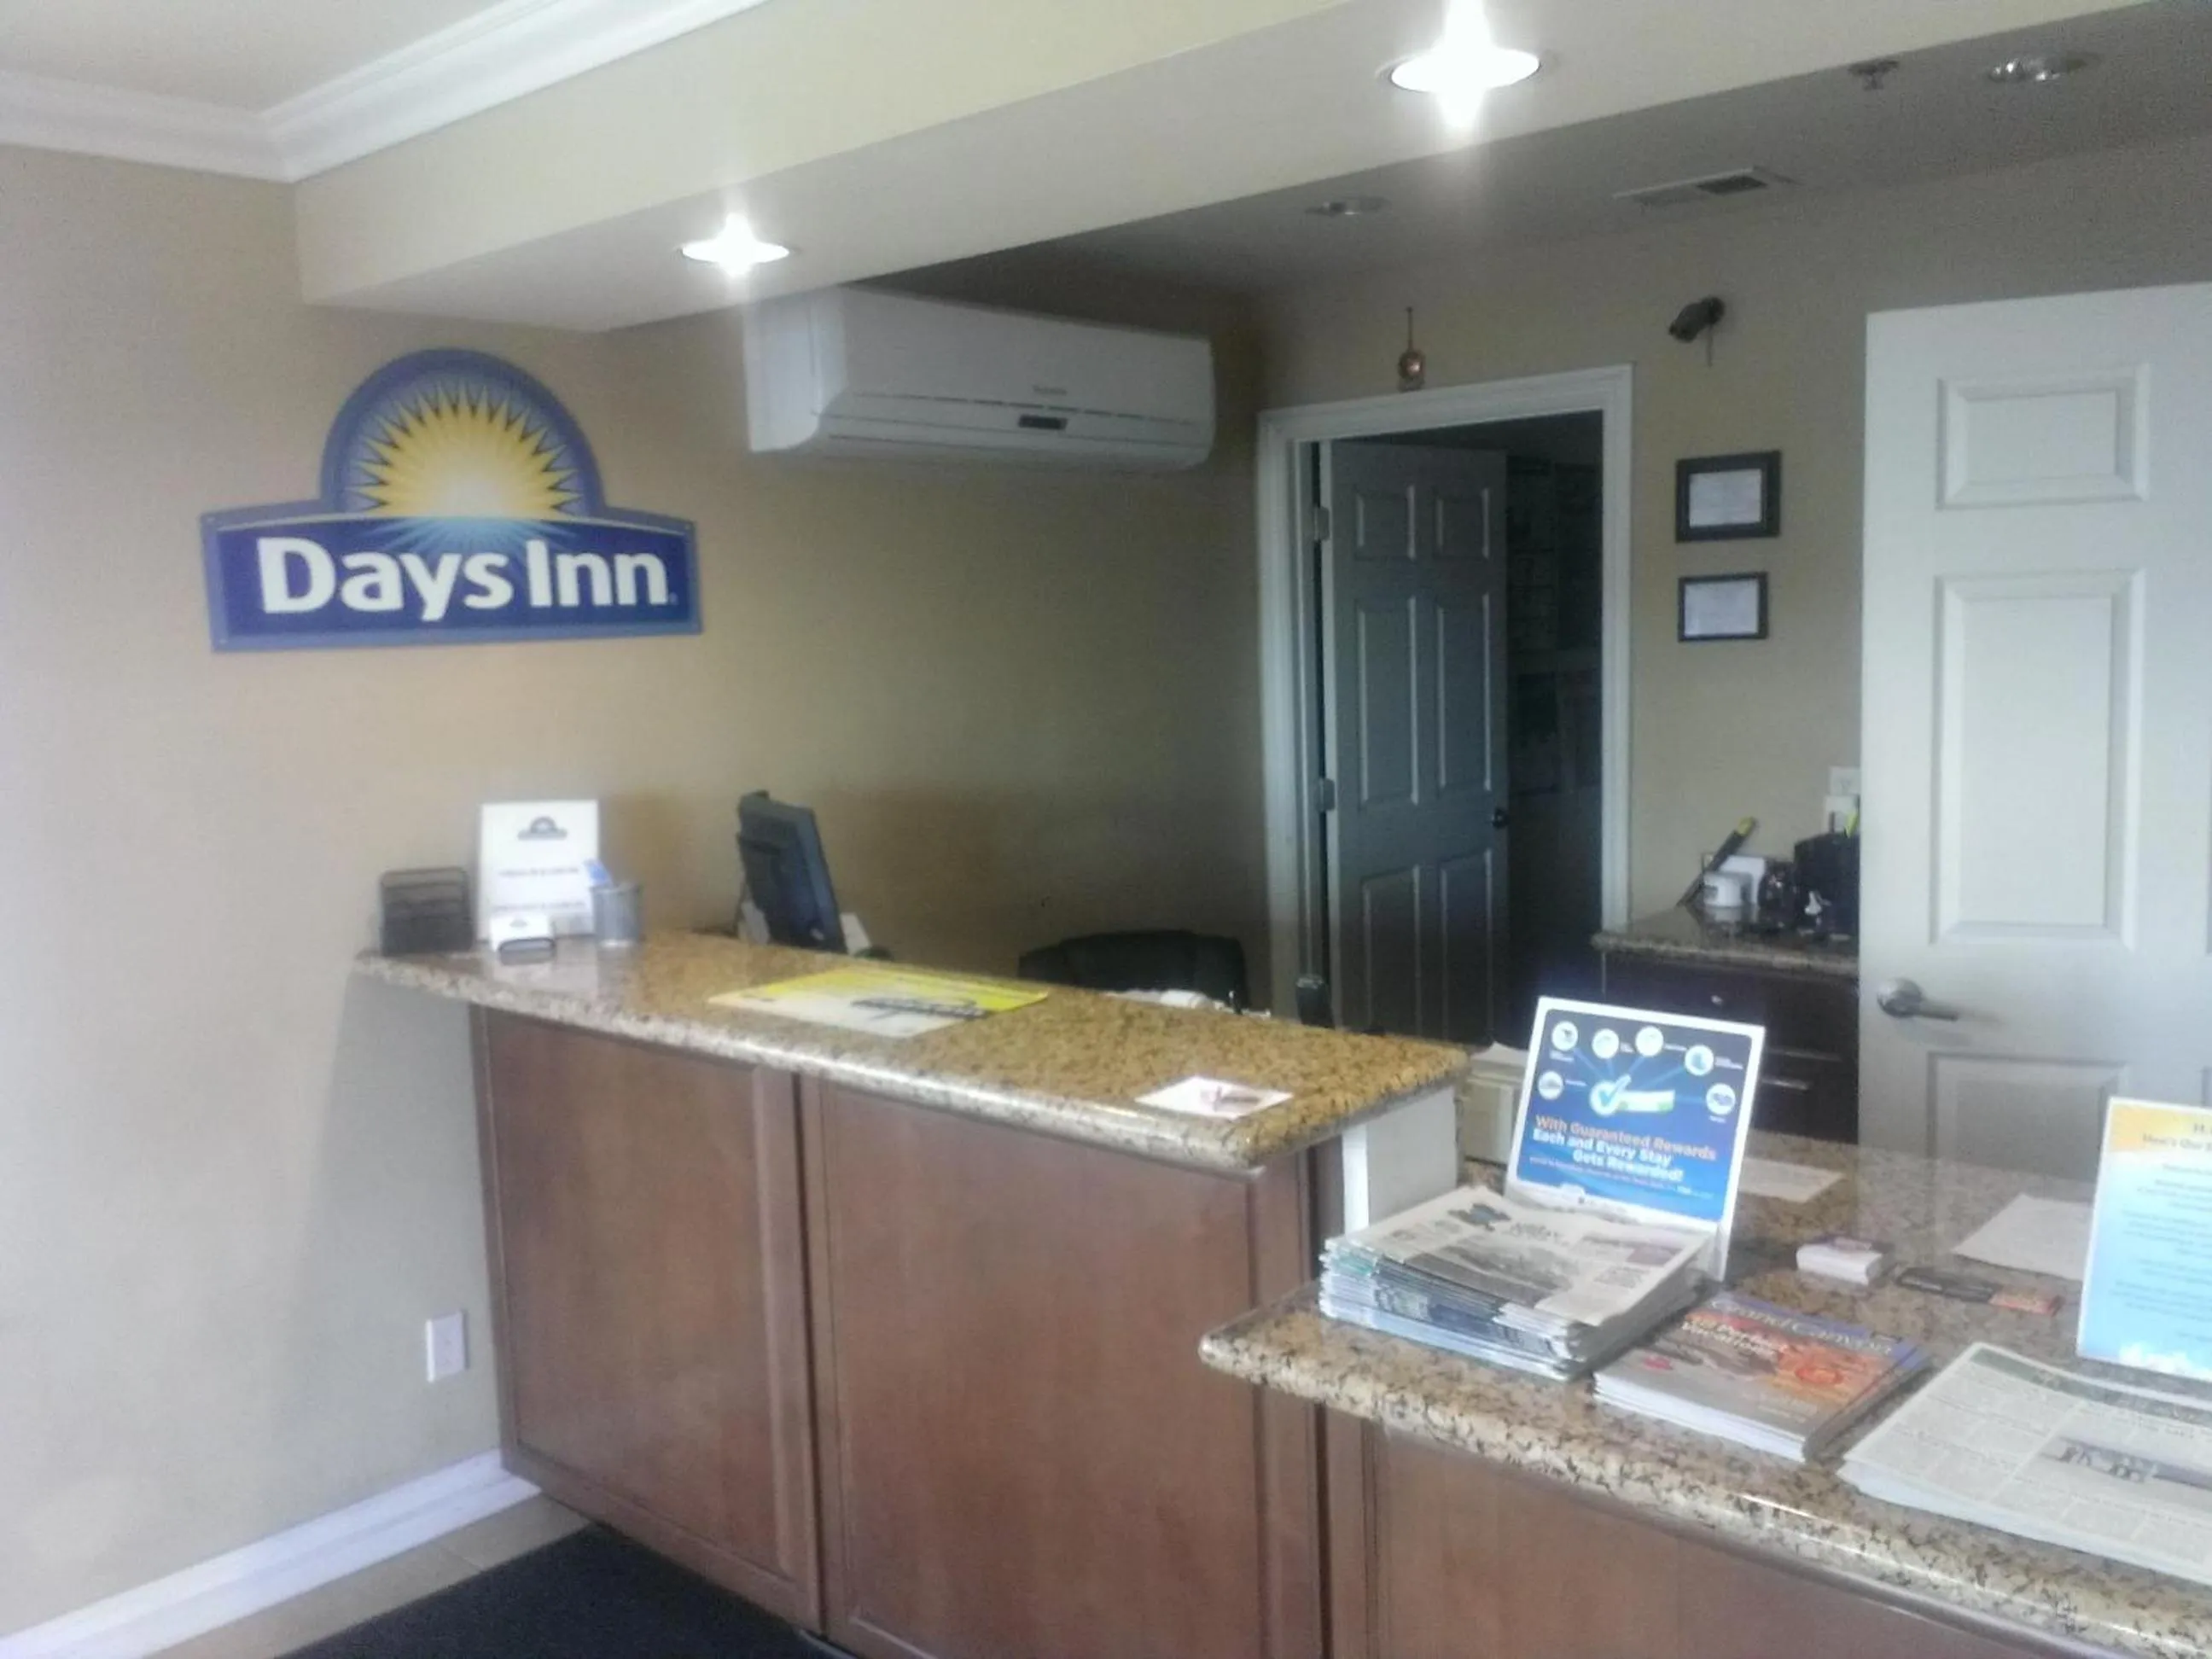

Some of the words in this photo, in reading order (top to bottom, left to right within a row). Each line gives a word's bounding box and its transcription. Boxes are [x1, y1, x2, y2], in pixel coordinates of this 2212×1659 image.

[256, 537, 515, 622] Days
[525, 539, 669, 608] Inn
[1533, 1127, 1565, 1146] Each
[1567, 1135, 1594, 1151] and
[1596, 1139, 1636, 1161] Every
[1639, 1147, 1674, 1167] Stay
[1535, 1115, 1568, 1132] With
[1570, 1121, 1650, 1148] Guaranteed
[1653, 1136, 1717, 1161] Rewards
[1572, 1149, 1604, 1167] Gets
